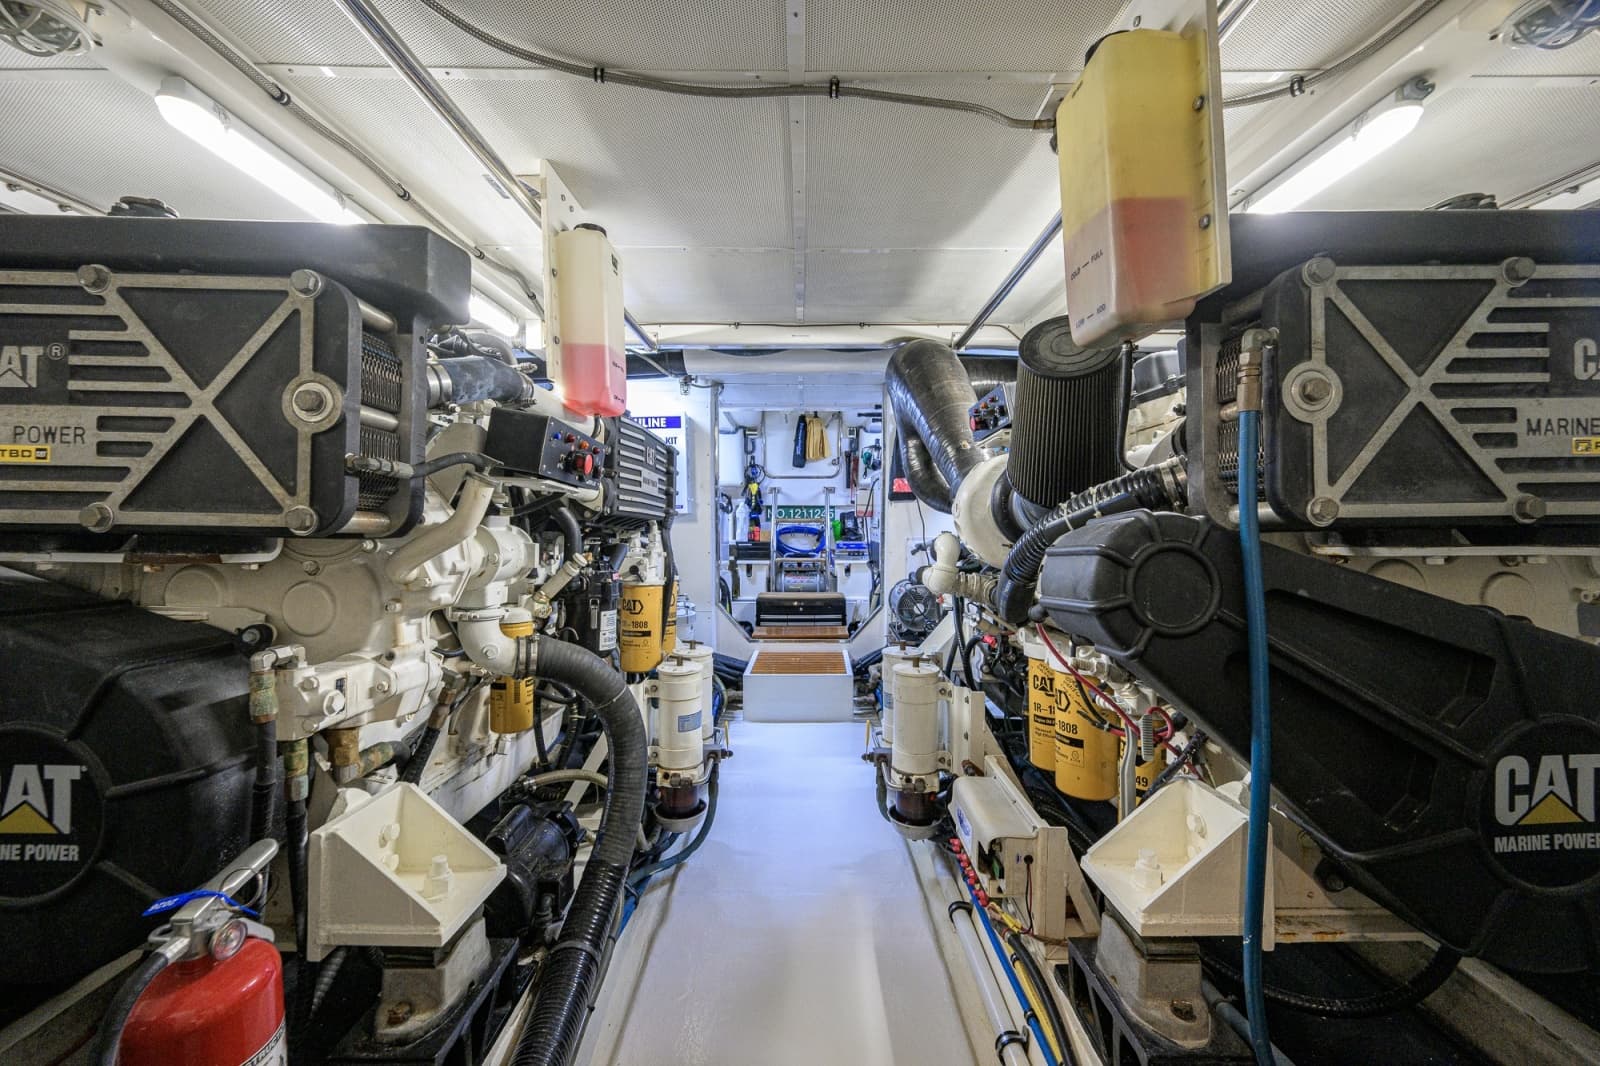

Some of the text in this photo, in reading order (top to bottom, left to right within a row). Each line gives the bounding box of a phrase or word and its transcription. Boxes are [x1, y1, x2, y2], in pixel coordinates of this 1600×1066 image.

[13, 425, 86, 444] POWER
[1526, 417, 1600, 437] MARINE
[665, 436, 678, 445] KIT
[1033, 674, 1055, 692] CAT
[1494, 753, 1600, 826] CAT
[0, 764, 81, 835] AT
[24, 844, 80, 861] POWER
[1494, 834, 1551, 853] MARINE
